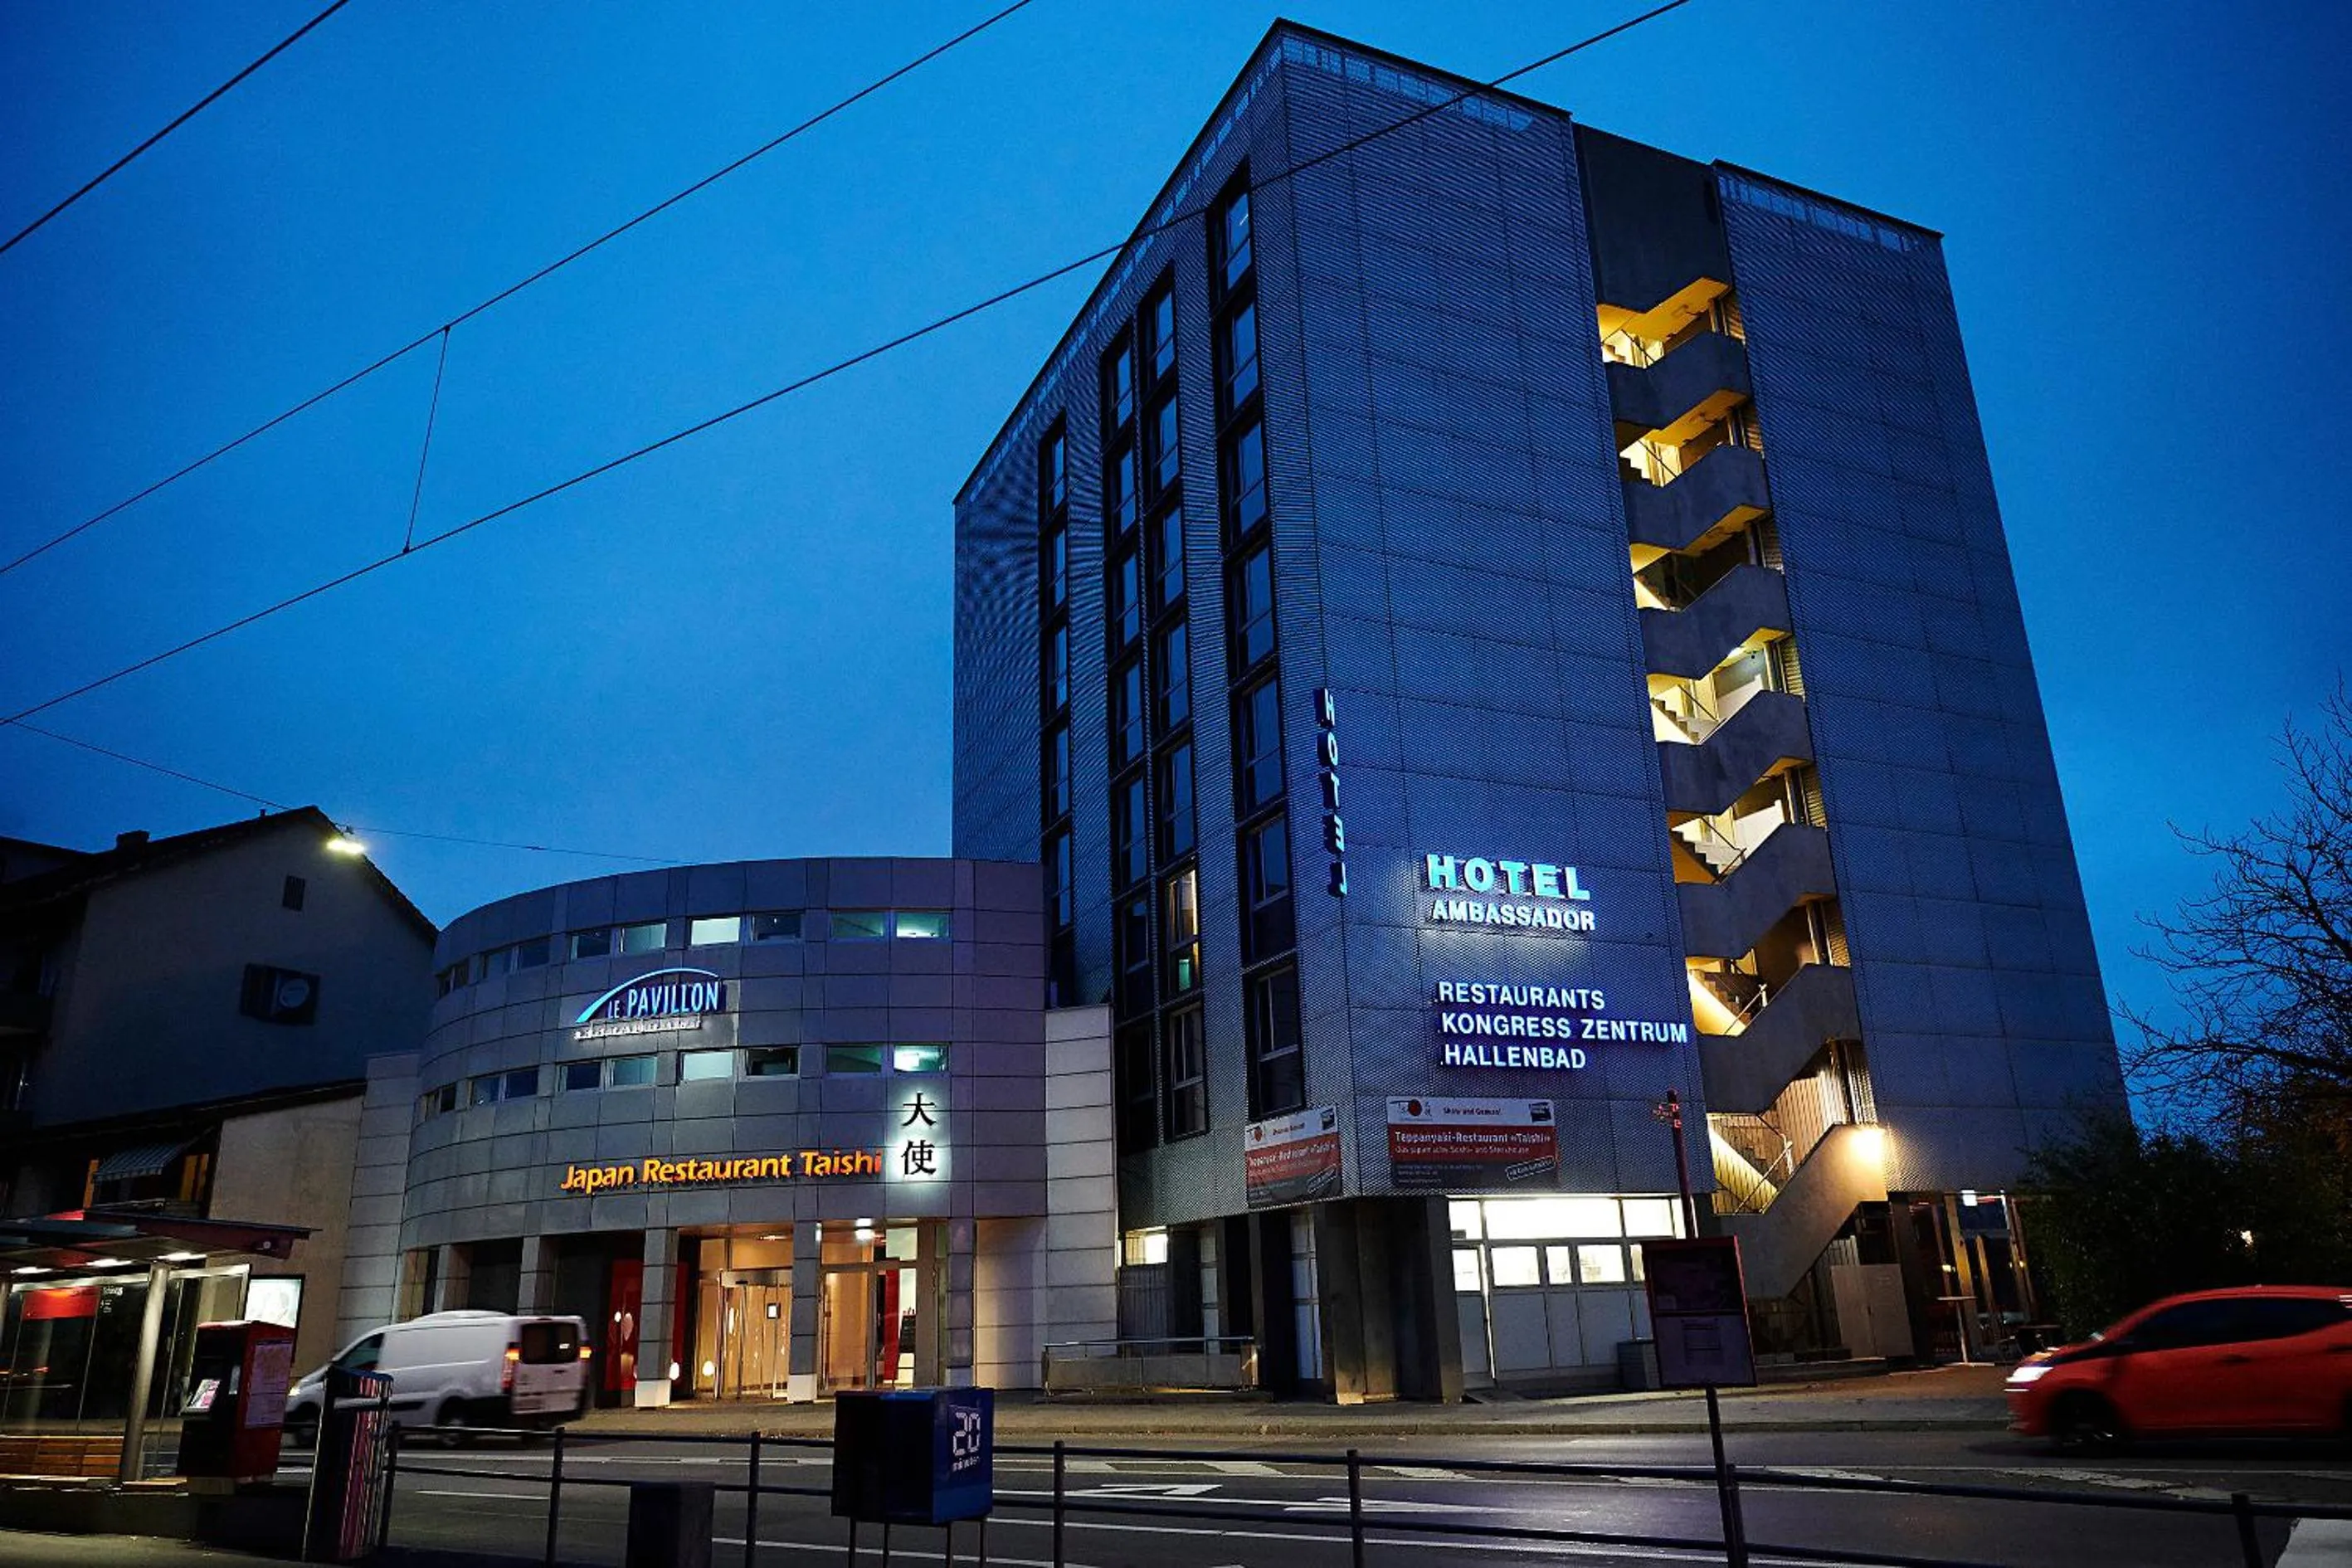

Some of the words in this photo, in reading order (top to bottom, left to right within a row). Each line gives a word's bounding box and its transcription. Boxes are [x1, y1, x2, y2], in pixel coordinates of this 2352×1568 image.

[1427, 854, 1590, 901] HOTEL
[1432, 899, 1595, 931] AMBASSADOR
[607, 1000, 621, 1019] LE
[627, 981, 719, 1017] PAVILLON
[1580, 1019, 1688, 1044] ZENTRUM
[901, 1092, 937, 1175] 大使
[560, 1165, 634, 1195] Japan
[642, 1154, 791, 1183] Restaurant
[800, 1147, 883, 1176] Taishi
[952, 1412, 980, 1456] 20
